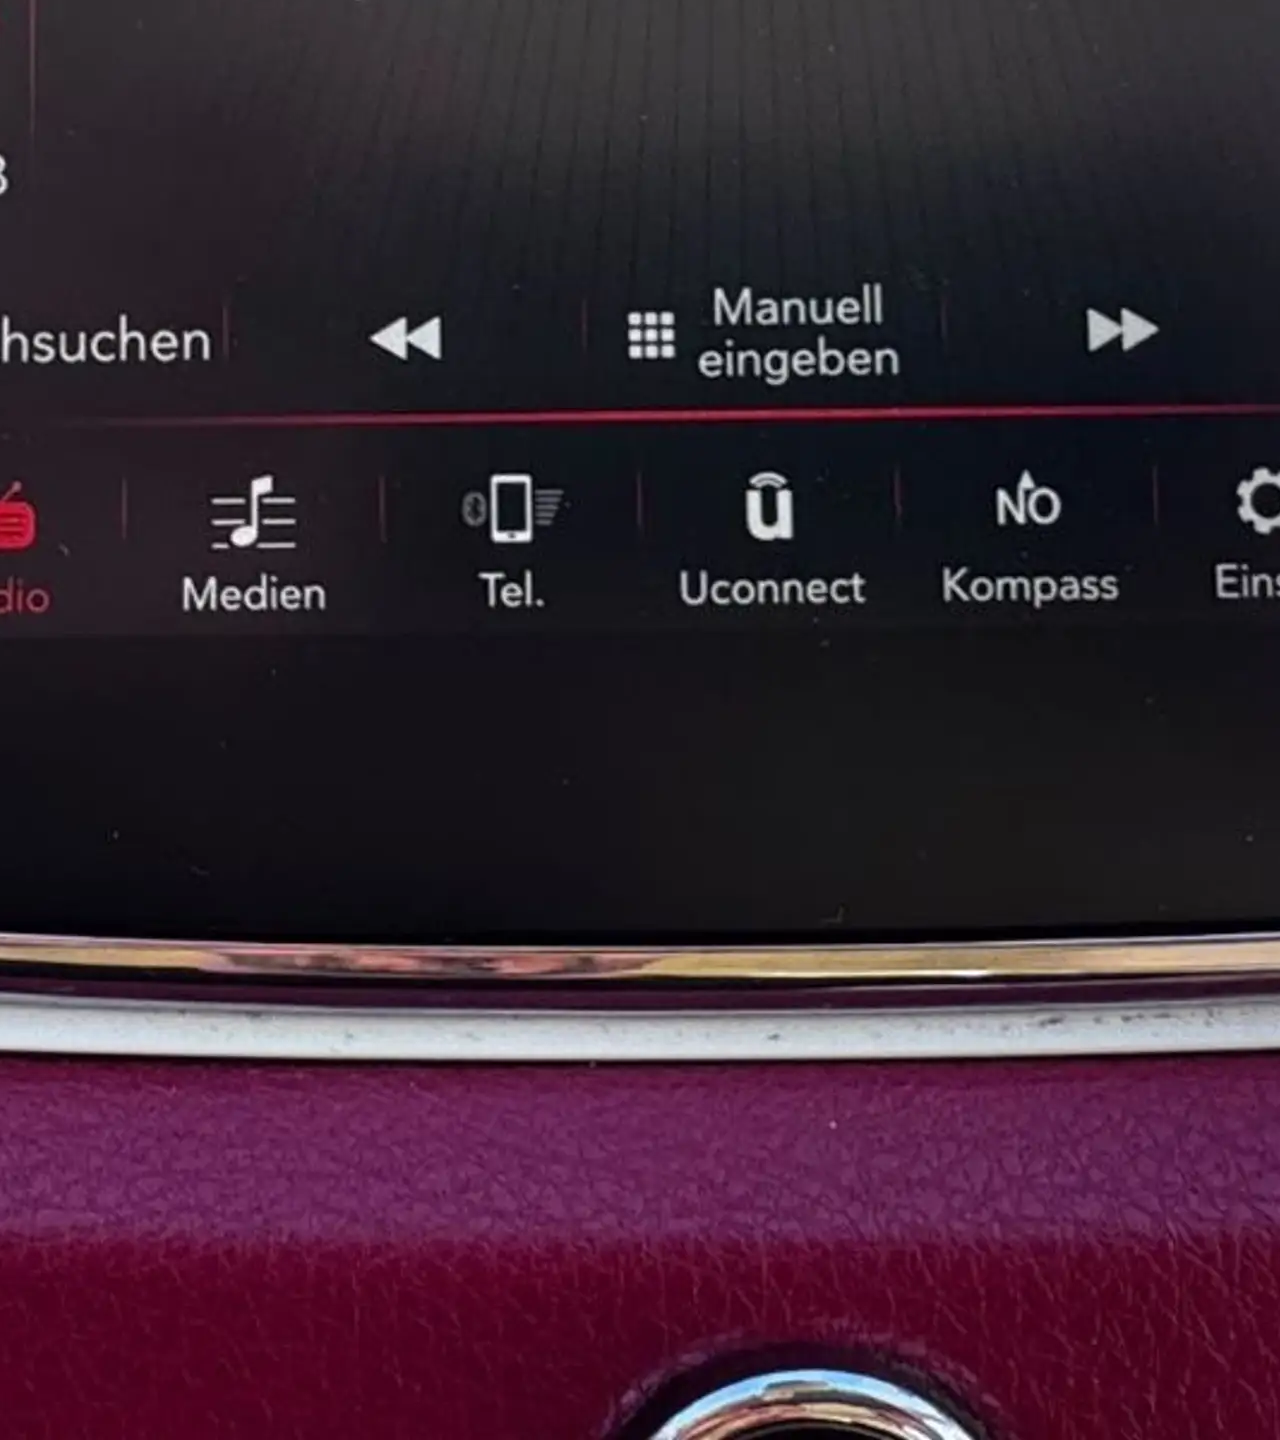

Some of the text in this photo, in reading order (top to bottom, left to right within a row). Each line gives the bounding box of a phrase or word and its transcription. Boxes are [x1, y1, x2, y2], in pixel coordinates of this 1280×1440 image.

[713, 283, 884, 327] Manuell
[697, 336, 901, 386] eingeben
[181, 574, 327, 612] Medien
[478, 570, 546, 609] Tel.
[679, 570, 867, 605] Uconnect
[941, 566, 1120, 610] Kompass
